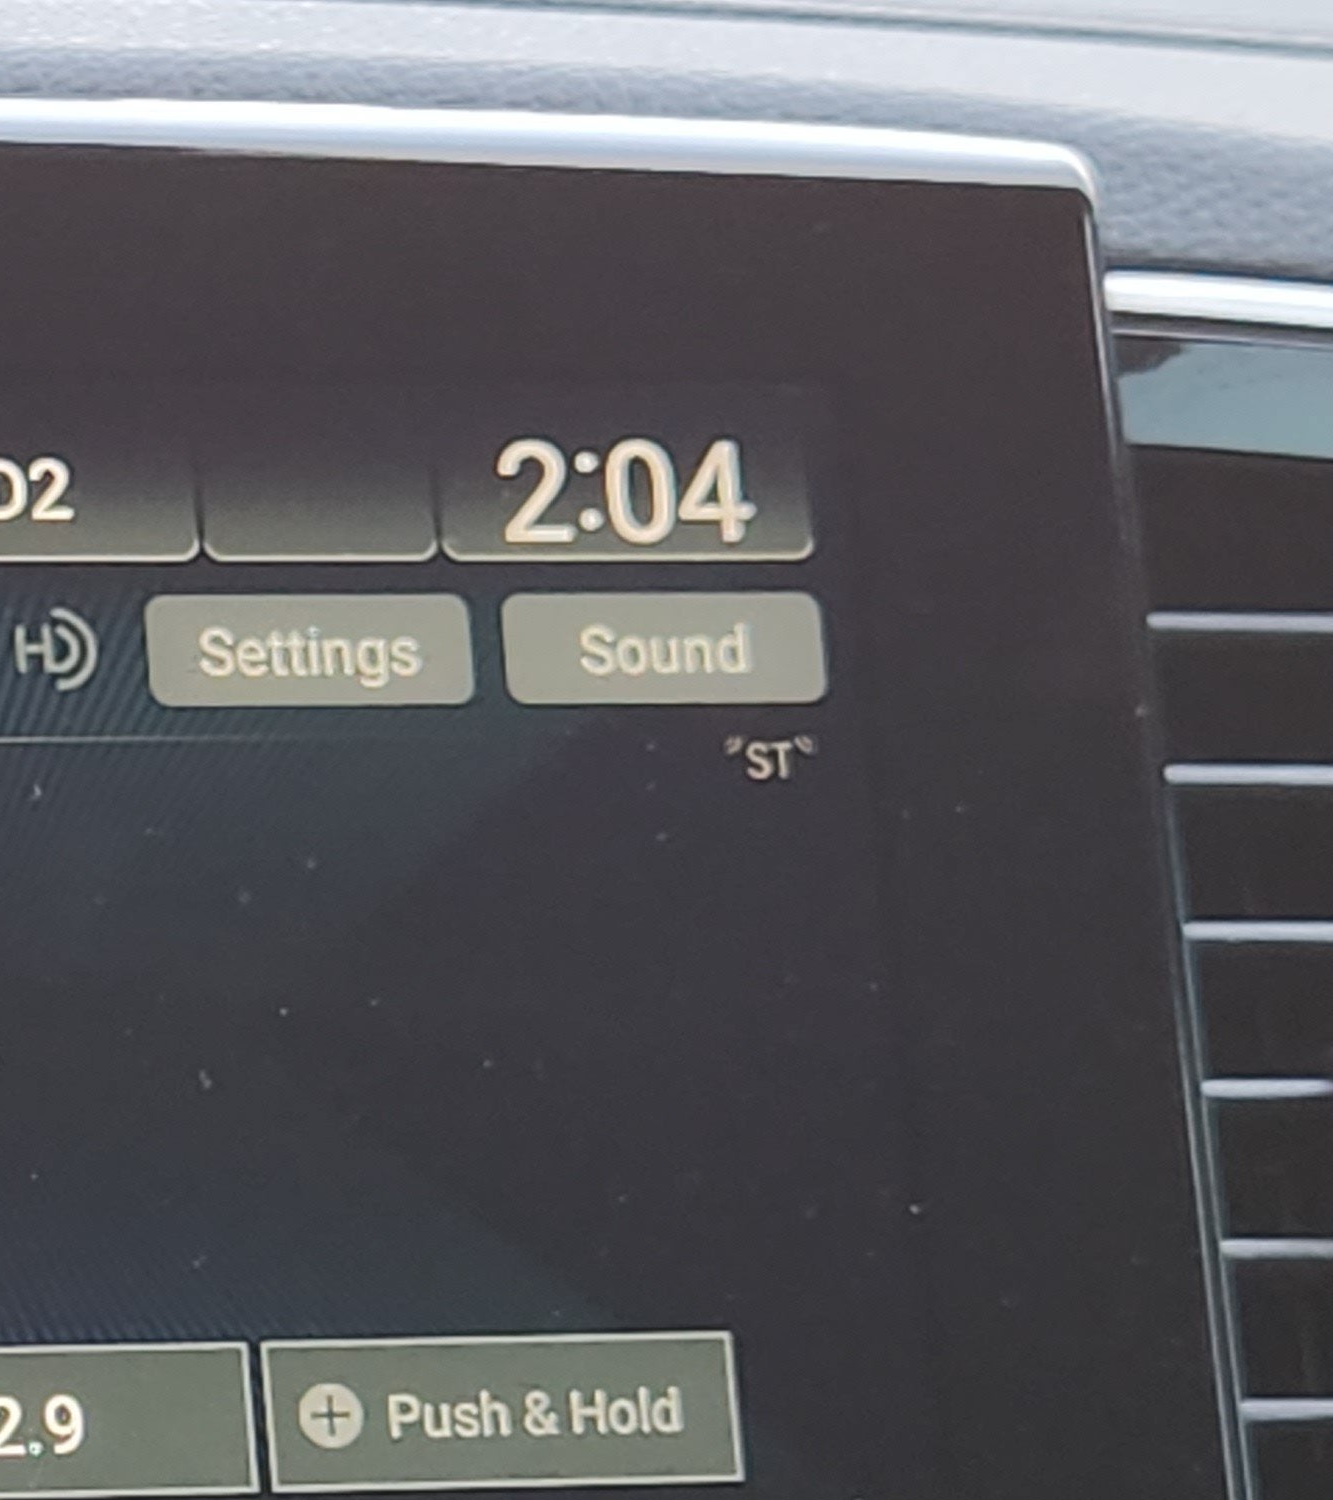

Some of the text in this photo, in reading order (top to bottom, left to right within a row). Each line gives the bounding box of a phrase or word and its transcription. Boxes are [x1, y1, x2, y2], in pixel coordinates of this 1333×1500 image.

[496, 438, 755, 544] 2:04
[199, 626, 422, 688] Settings
[580, 624, 751, 677] Sound
[388, 1385, 684, 1439] Push & Hold
